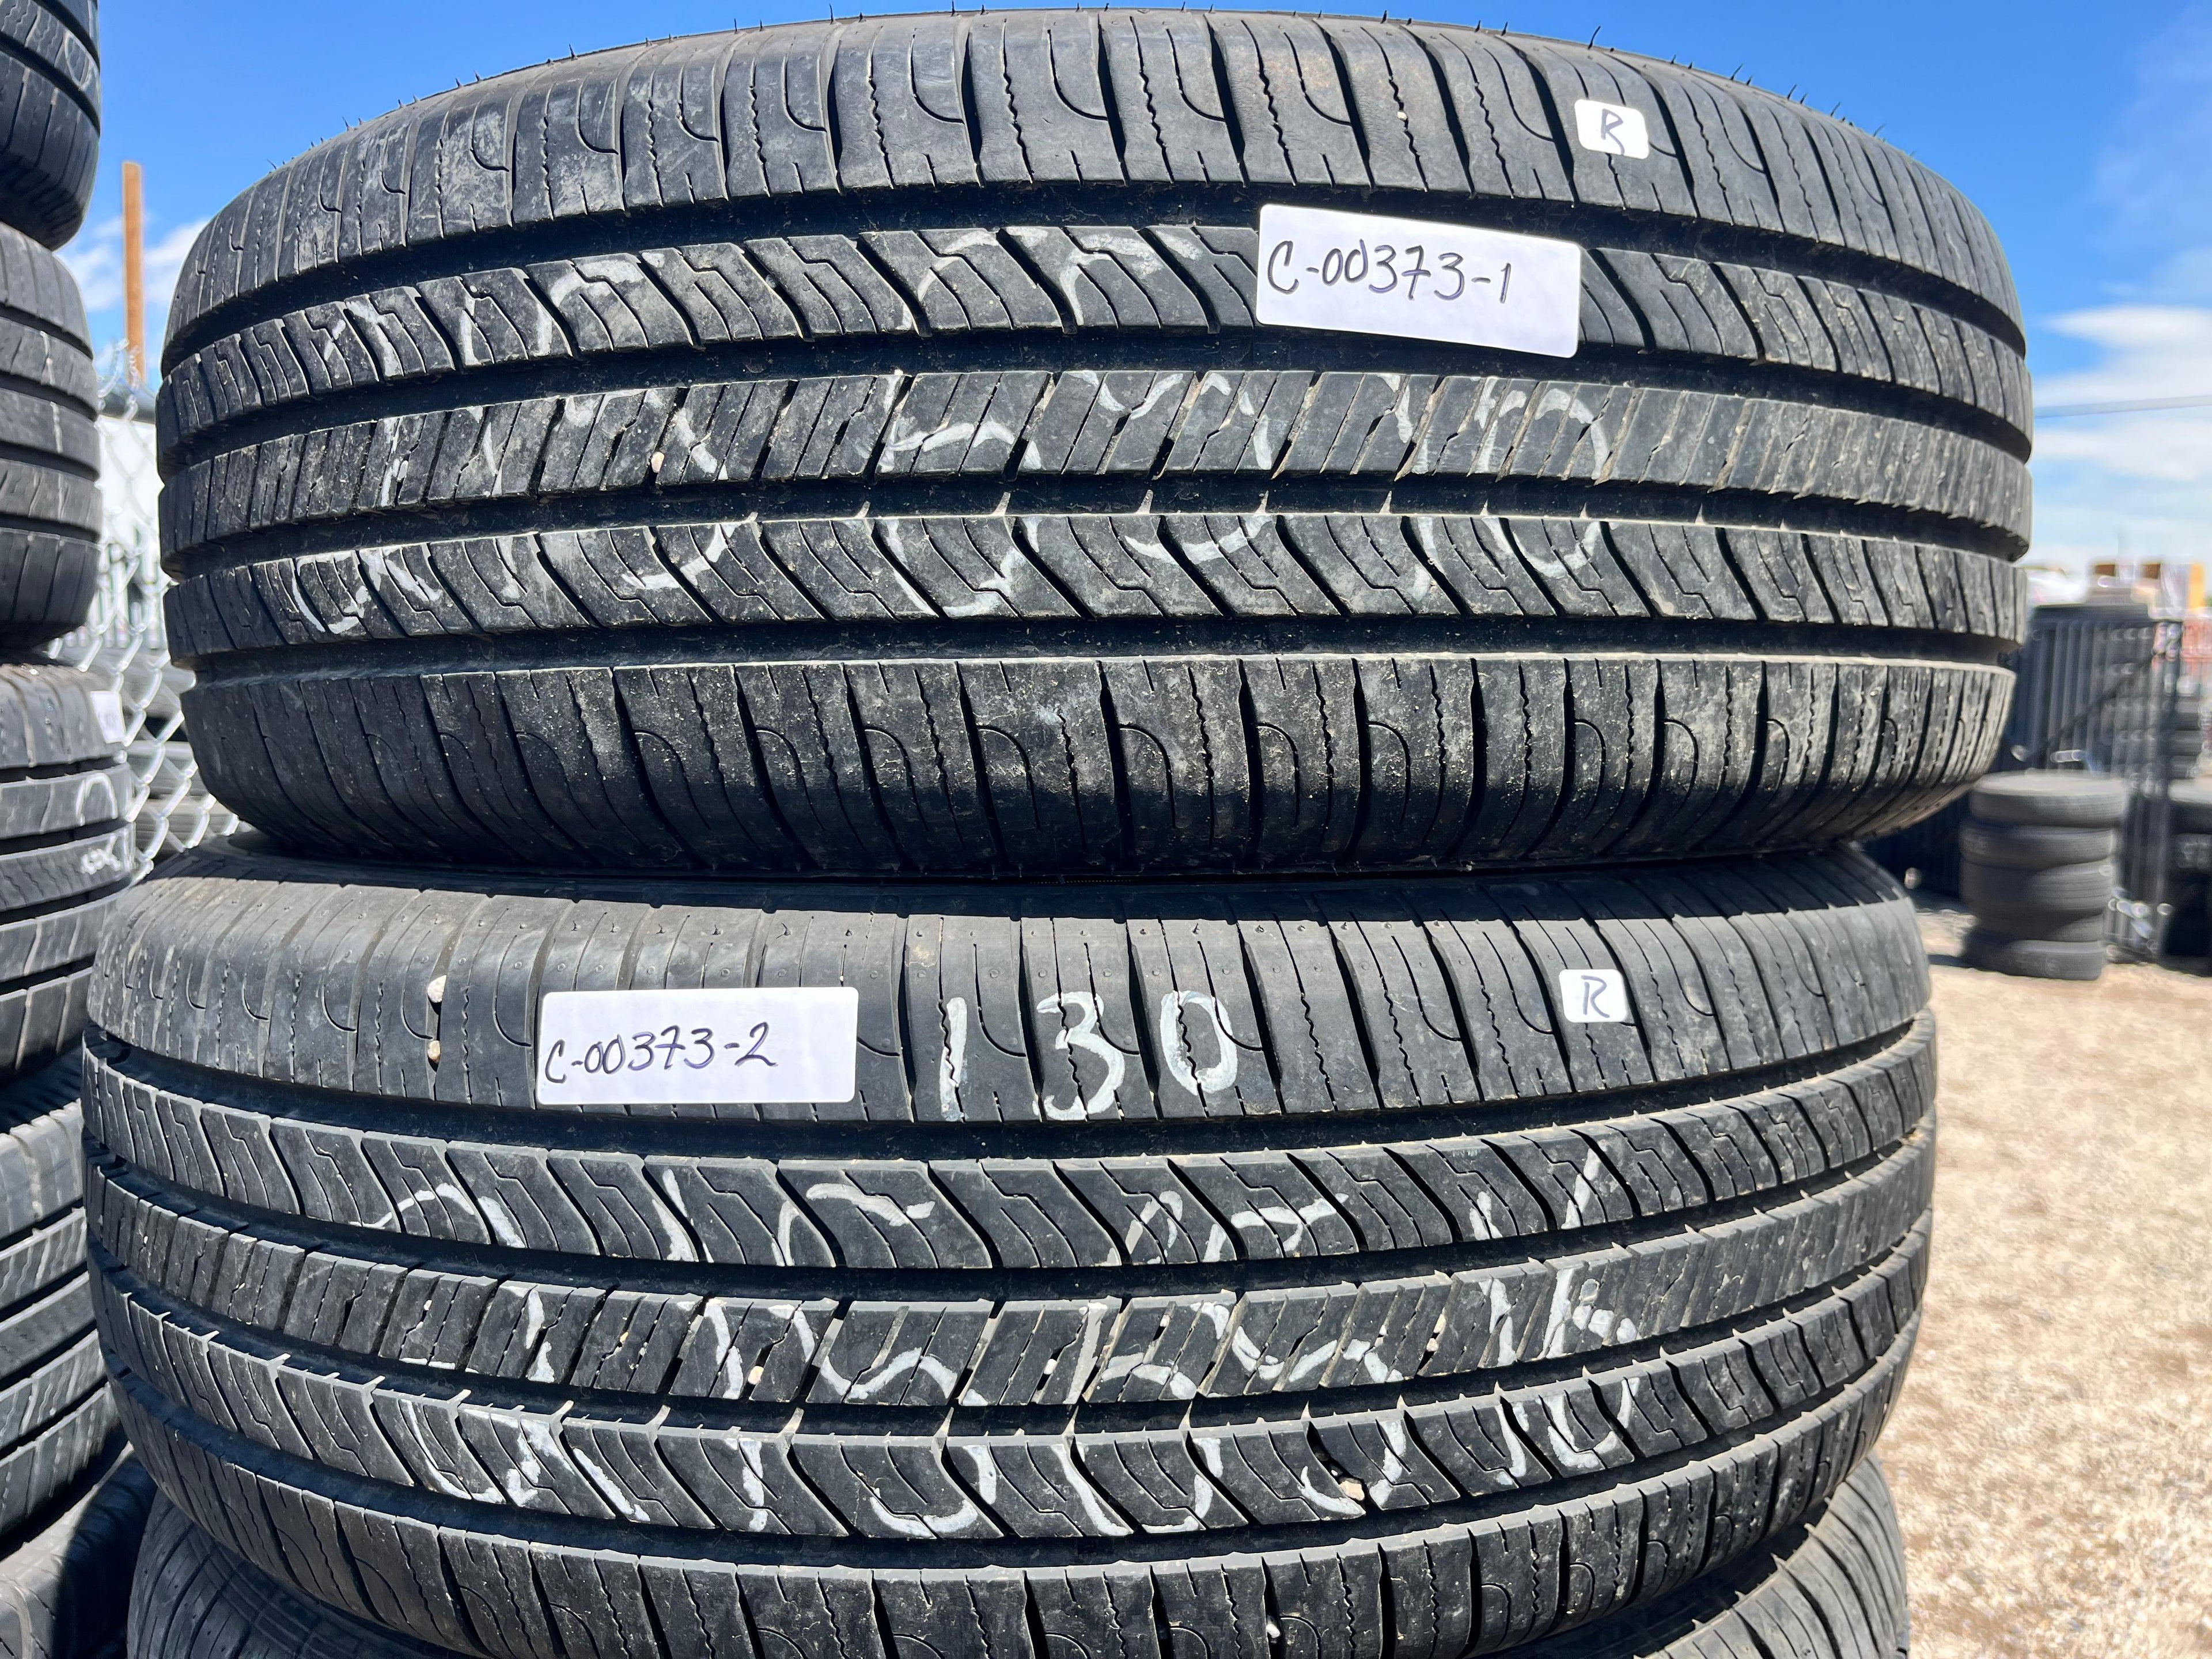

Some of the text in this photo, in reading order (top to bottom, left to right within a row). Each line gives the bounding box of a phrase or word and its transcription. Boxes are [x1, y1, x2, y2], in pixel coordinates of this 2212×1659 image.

[1600, 108, 1626, 156] R
[1267, 238, 1512, 304] C-00373-1
[1580, 975, 1611, 1018] R
[544, 1021, 779, 1084] C-00373-2
[938, 990, 1238, 1122] 130
